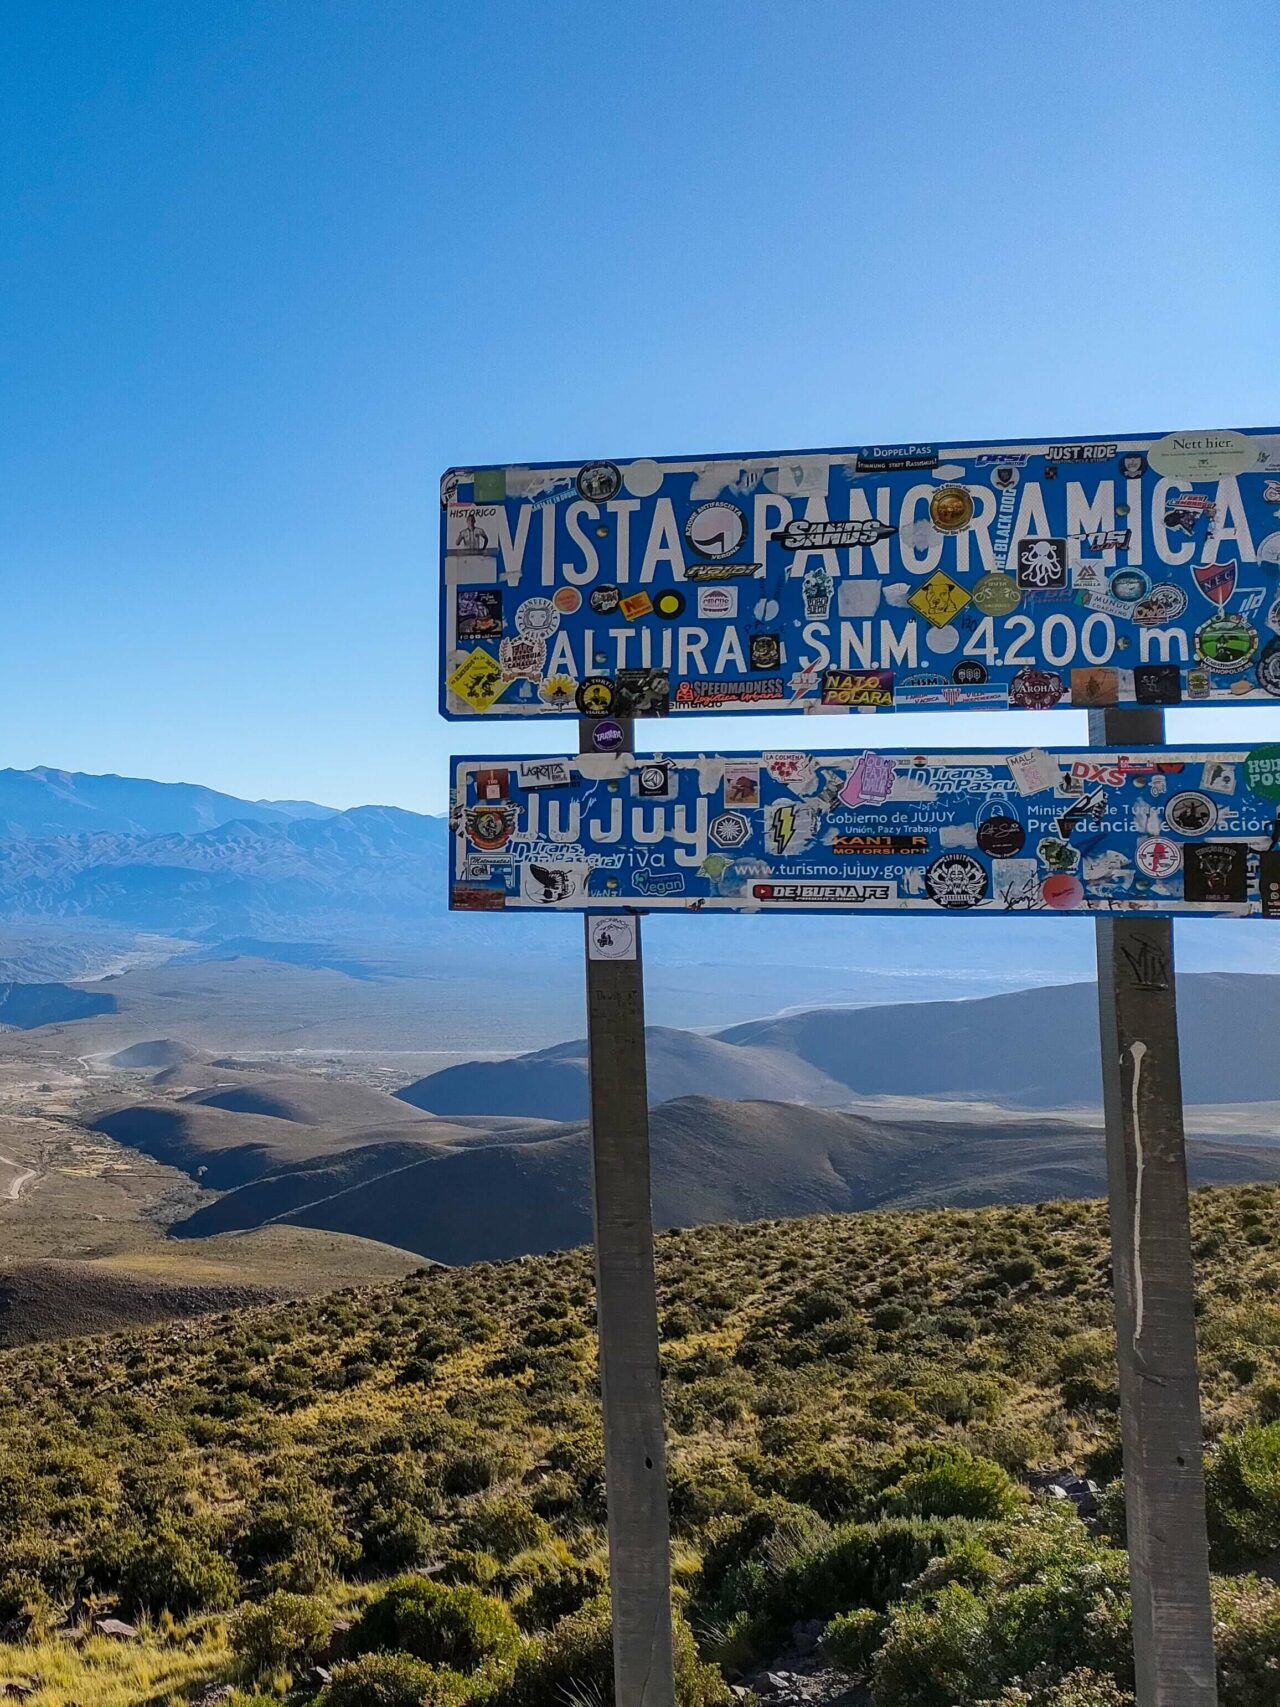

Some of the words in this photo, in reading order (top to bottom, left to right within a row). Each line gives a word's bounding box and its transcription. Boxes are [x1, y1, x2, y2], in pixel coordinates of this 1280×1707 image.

[1173, 438, 1202, 450] Nett
[1205, 437, 1234, 449] hier.
[1045, 445, 1083, 461] JUST
[1083, 443, 1118, 459] RIDE
[696, 501, 743, 517] ANTIFASCISTA
[497, 497, 688, 587] VISTA
[754, 476, 1258, 579] PANORAMICA
[994, 512, 1012, 552] BLACK
[711, 545, 741, 560] VERONA
[1094, 595, 1131, 611] MUNDO
[547, 624, 748, 678] ALTURA
[693, 679, 784, 698] SPEEDMADNESS
[1021, 683, 1055, 693] AROHA
[827, 691, 892, 704] POLARA
[1071, 761, 1126, 787] DXS
[826, 812, 888, 824] Gobierno
[891, 811, 908, 823] de
[911, 811, 956, 823] JUJUY
[845, 824, 876, 835] Unión,
[877, 825, 894, 834] Paz
[895, 826, 901, 835] y
[903, 824, 938, 836] Trabajo
[834, 836, 928, 845] KANTR
[773, 886, 797, 898] DE
[801, 886, 860, 898] BUENA
[864, 886, 890, 898] FE
